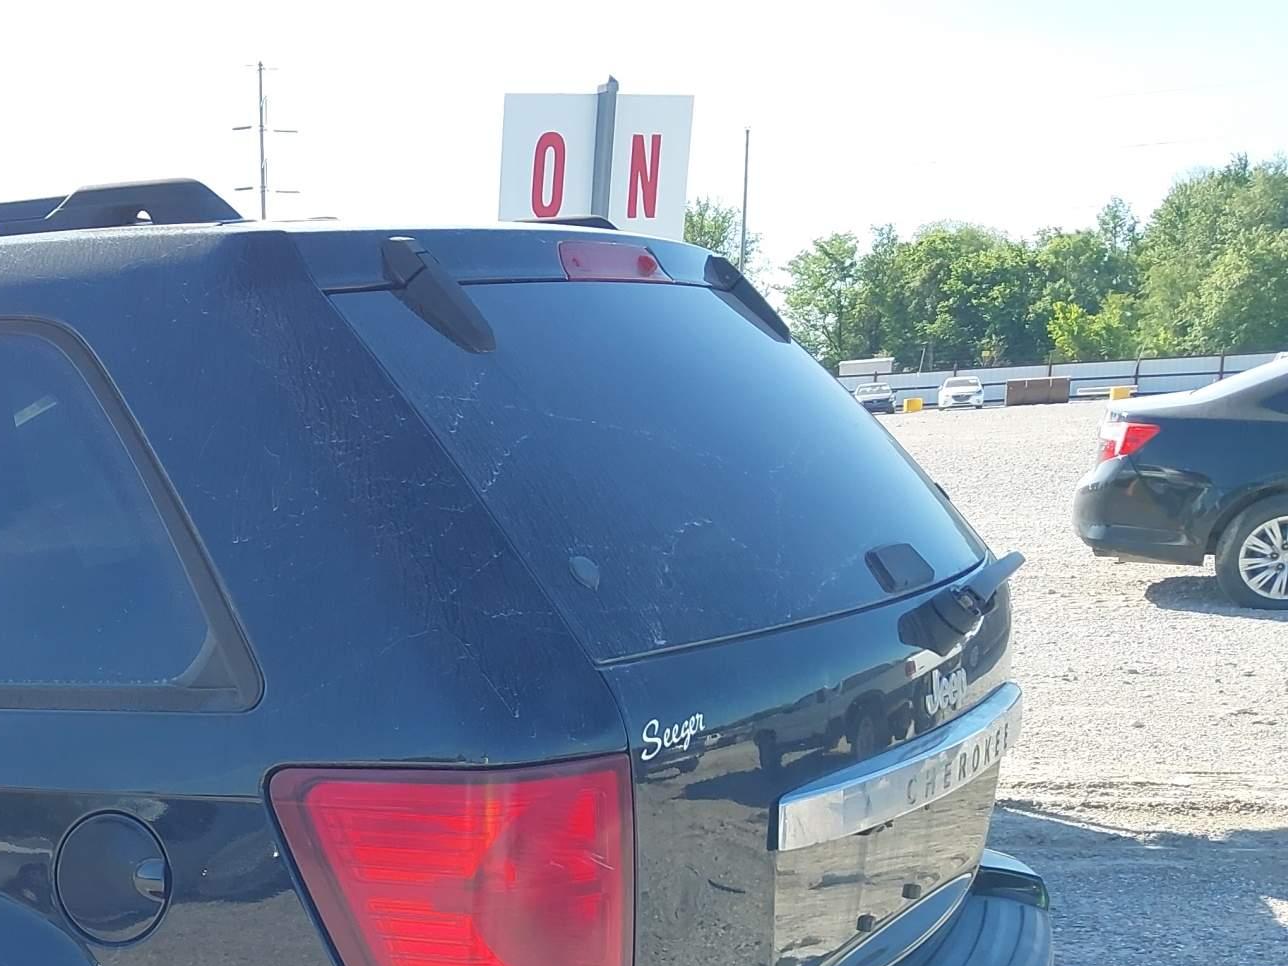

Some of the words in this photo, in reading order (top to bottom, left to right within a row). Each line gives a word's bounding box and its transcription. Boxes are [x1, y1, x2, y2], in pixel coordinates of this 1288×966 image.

[531, 131, 566, 218] O
[627, 133, 662, 218] N
[925, 668, 967, 716] Jeep
[641, 712, 706, 761] Seeger
[906, 722, 1010, 805] CHEROKEE
